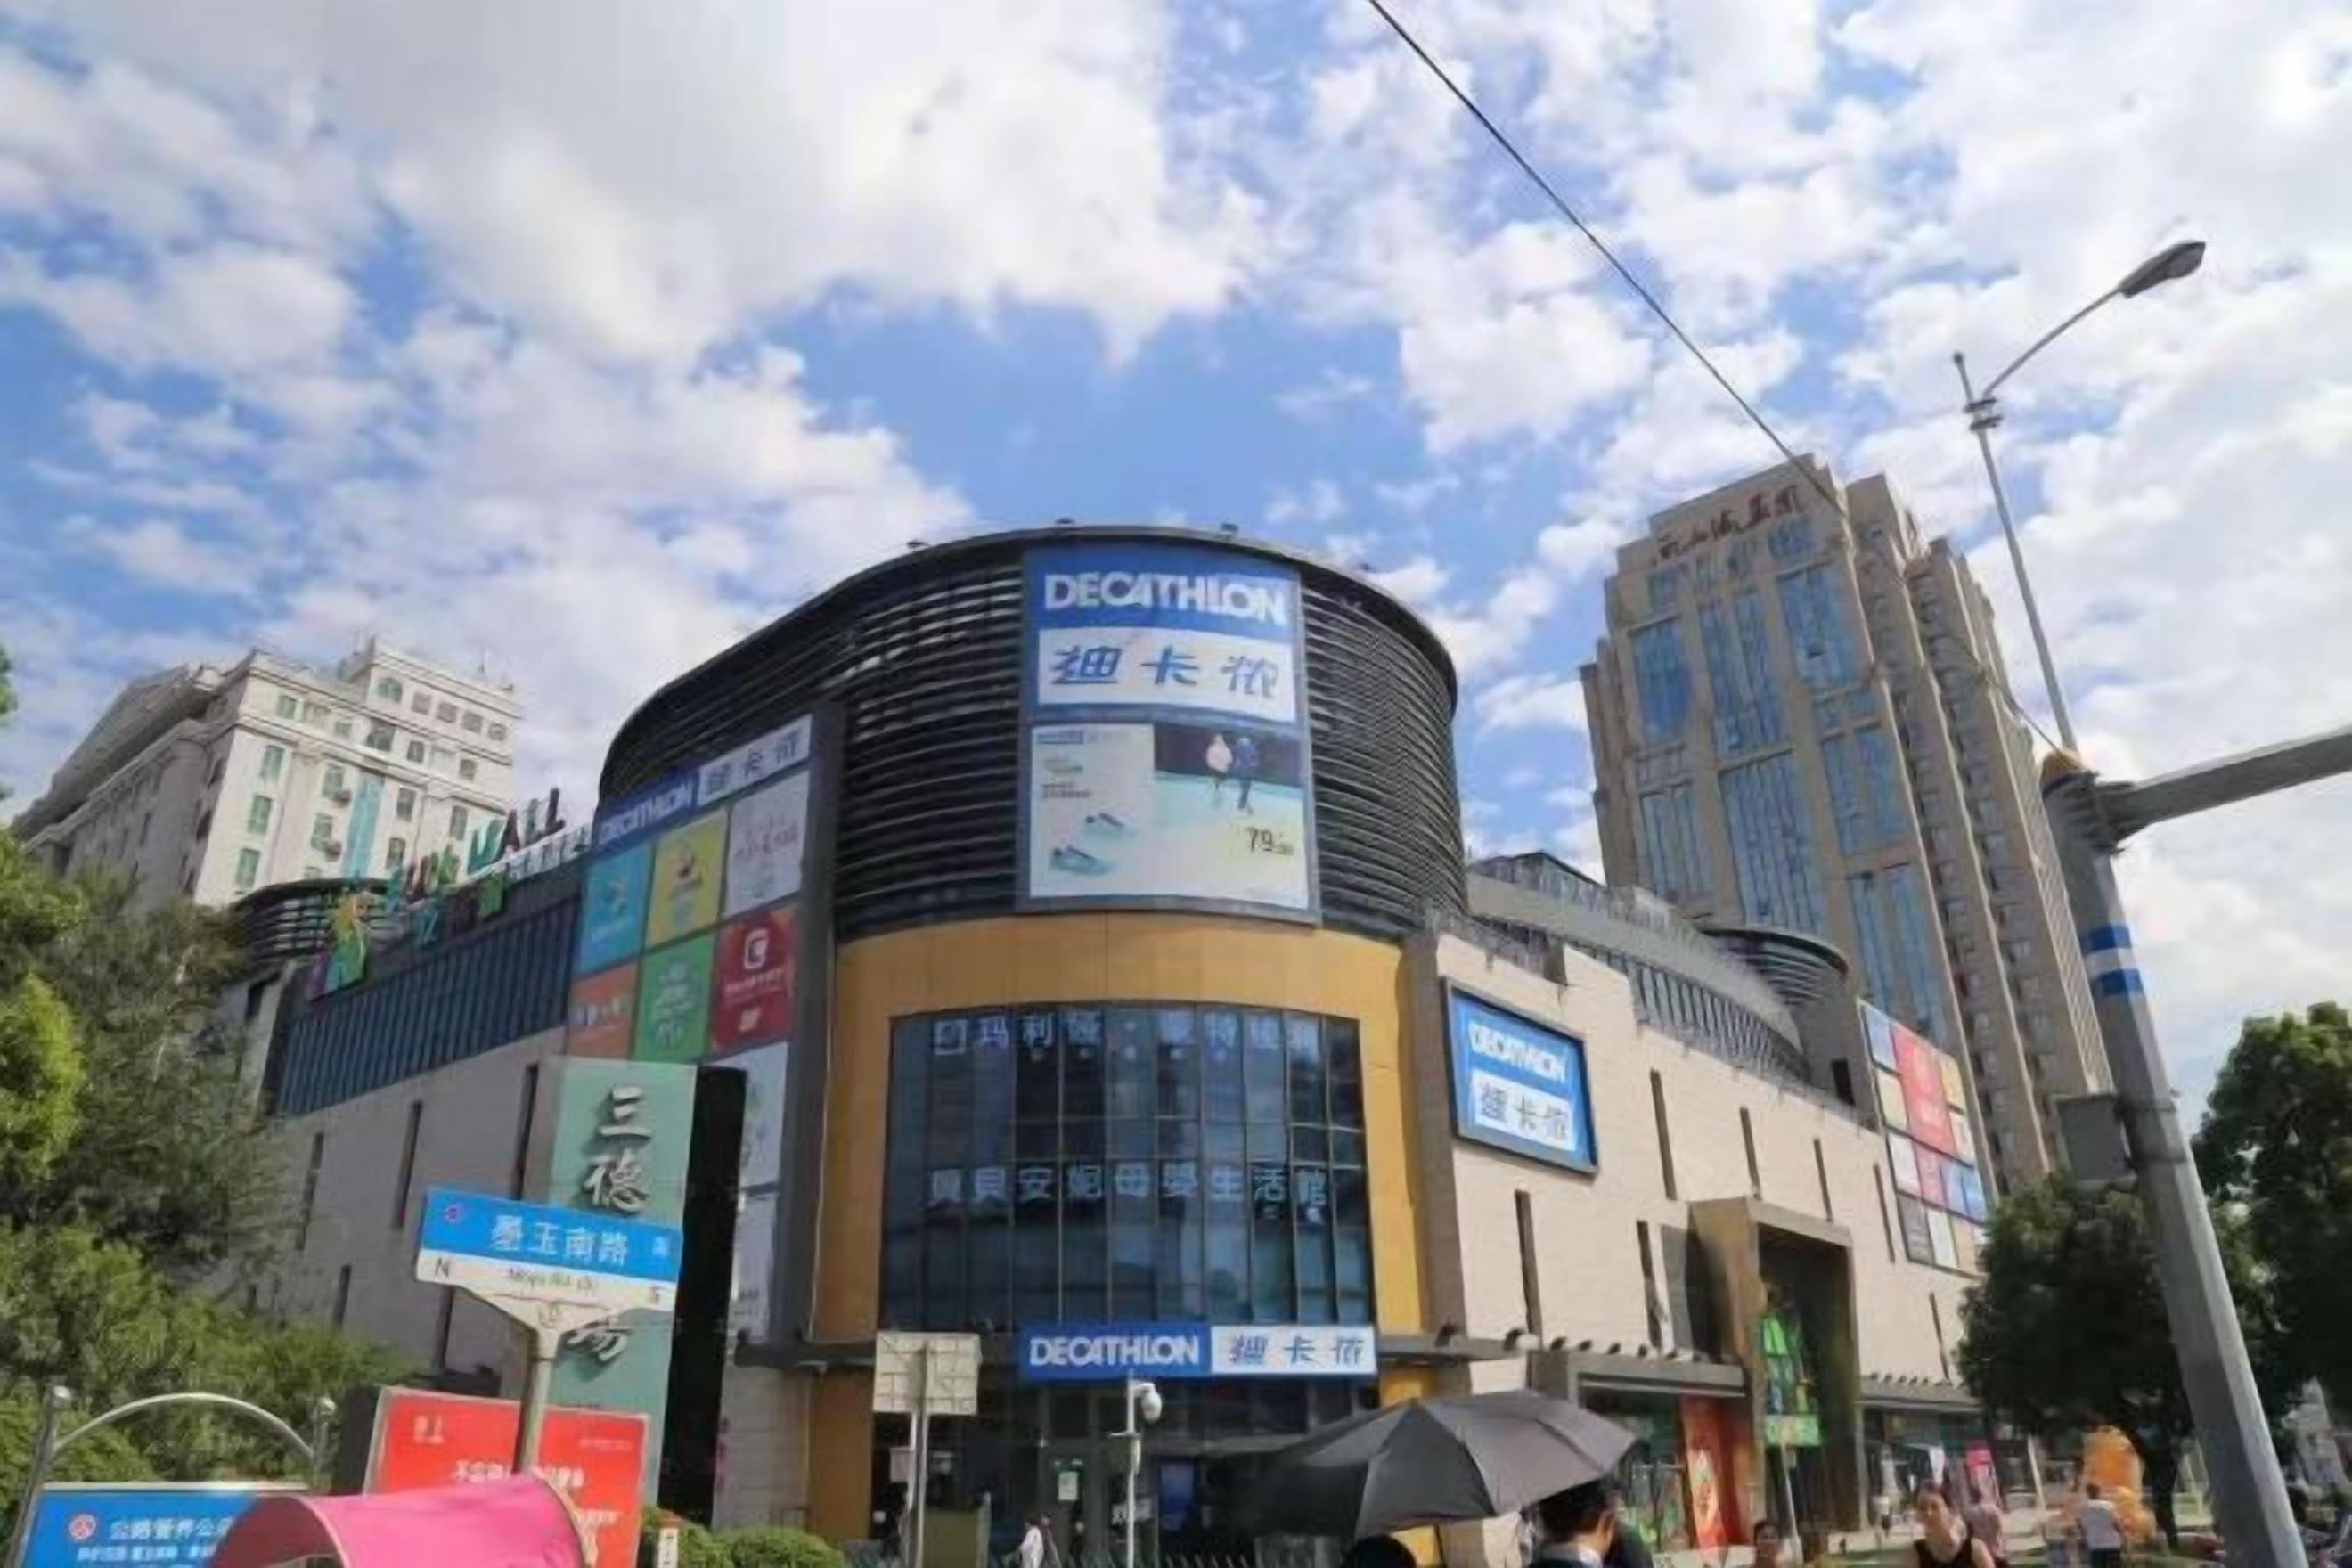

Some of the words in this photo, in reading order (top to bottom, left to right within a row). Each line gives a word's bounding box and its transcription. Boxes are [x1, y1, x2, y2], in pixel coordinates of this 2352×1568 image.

[1044, 571, 1290, 626] DECATHLON
[1051, 644, 1281, 700] 迪卡侬
[1030, 1335, 1199, 1367] DECATHLON
